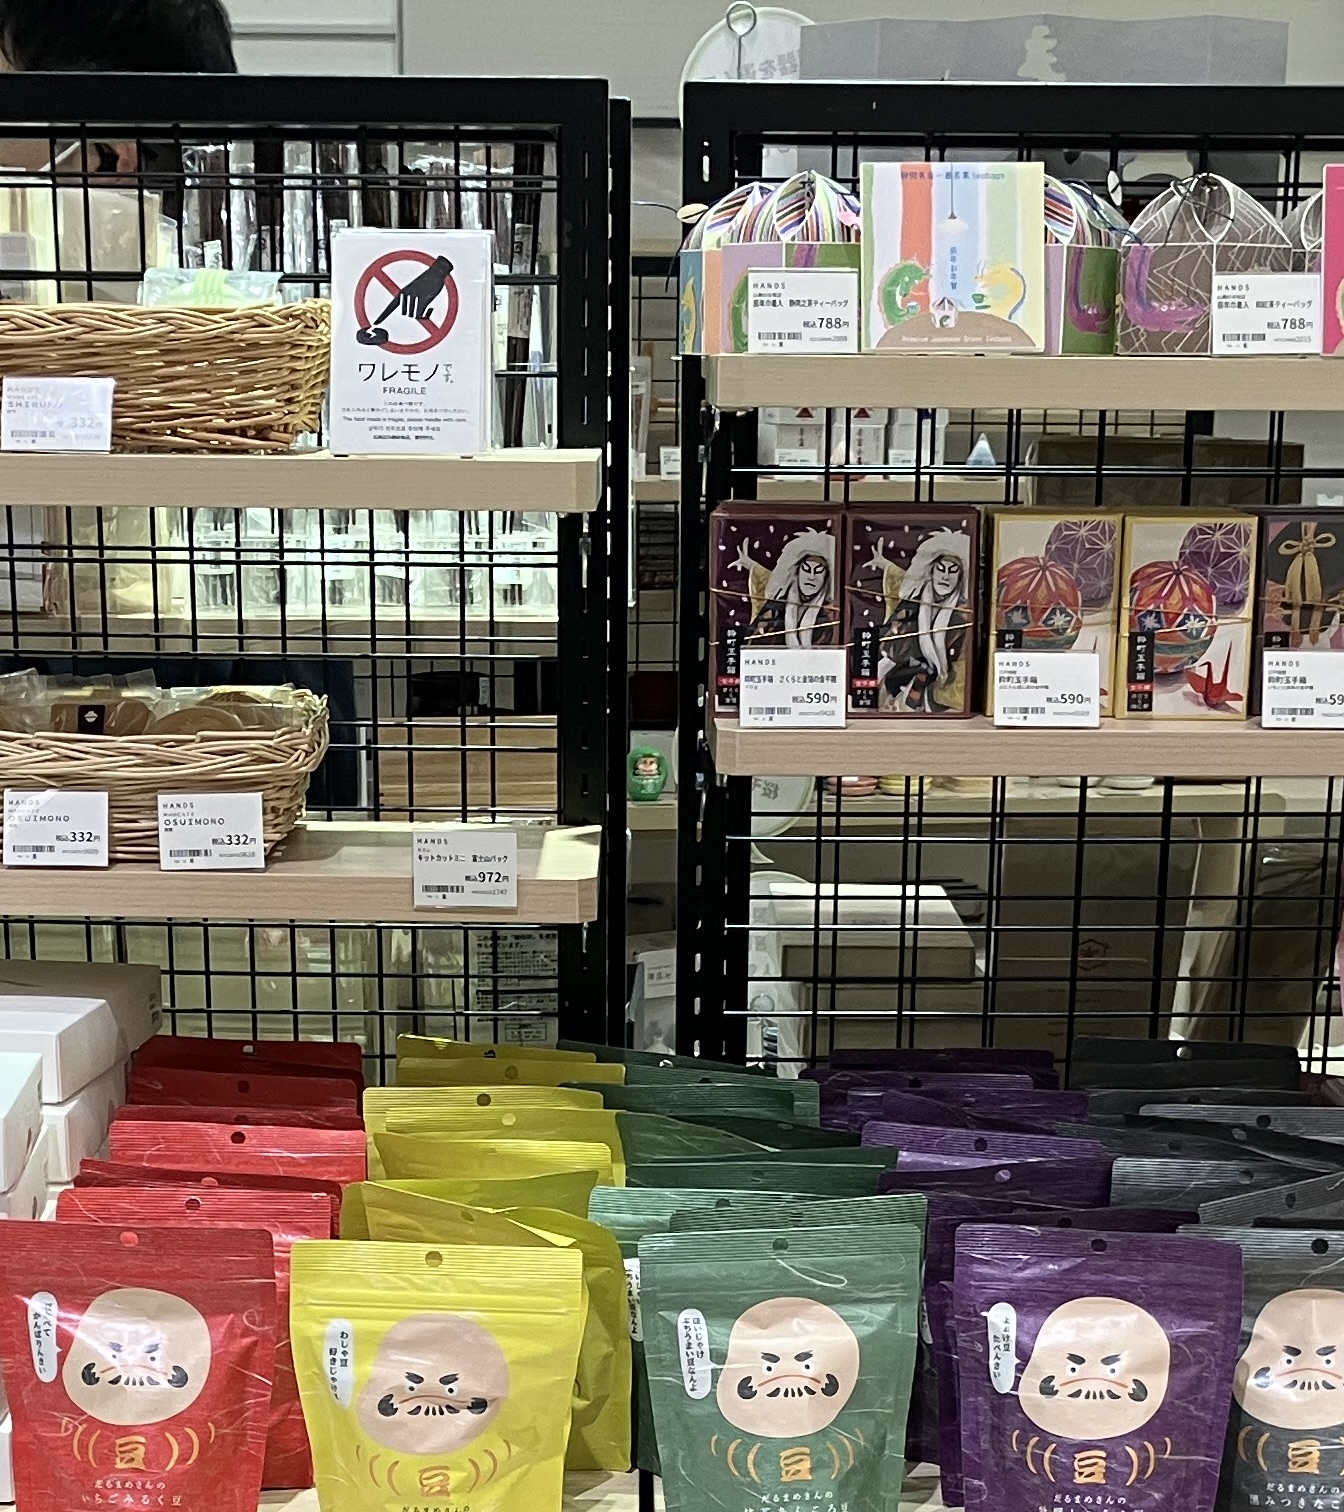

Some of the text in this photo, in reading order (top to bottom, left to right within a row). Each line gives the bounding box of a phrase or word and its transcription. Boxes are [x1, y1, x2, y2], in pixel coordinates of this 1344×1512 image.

[1216, 284, 1250, 292] HANDS
[358, 363, 439, 382] ワレモノ
[383, 387, 426, 395] FRAGILE
[164, 818, 225, 826] OSUIMONO
